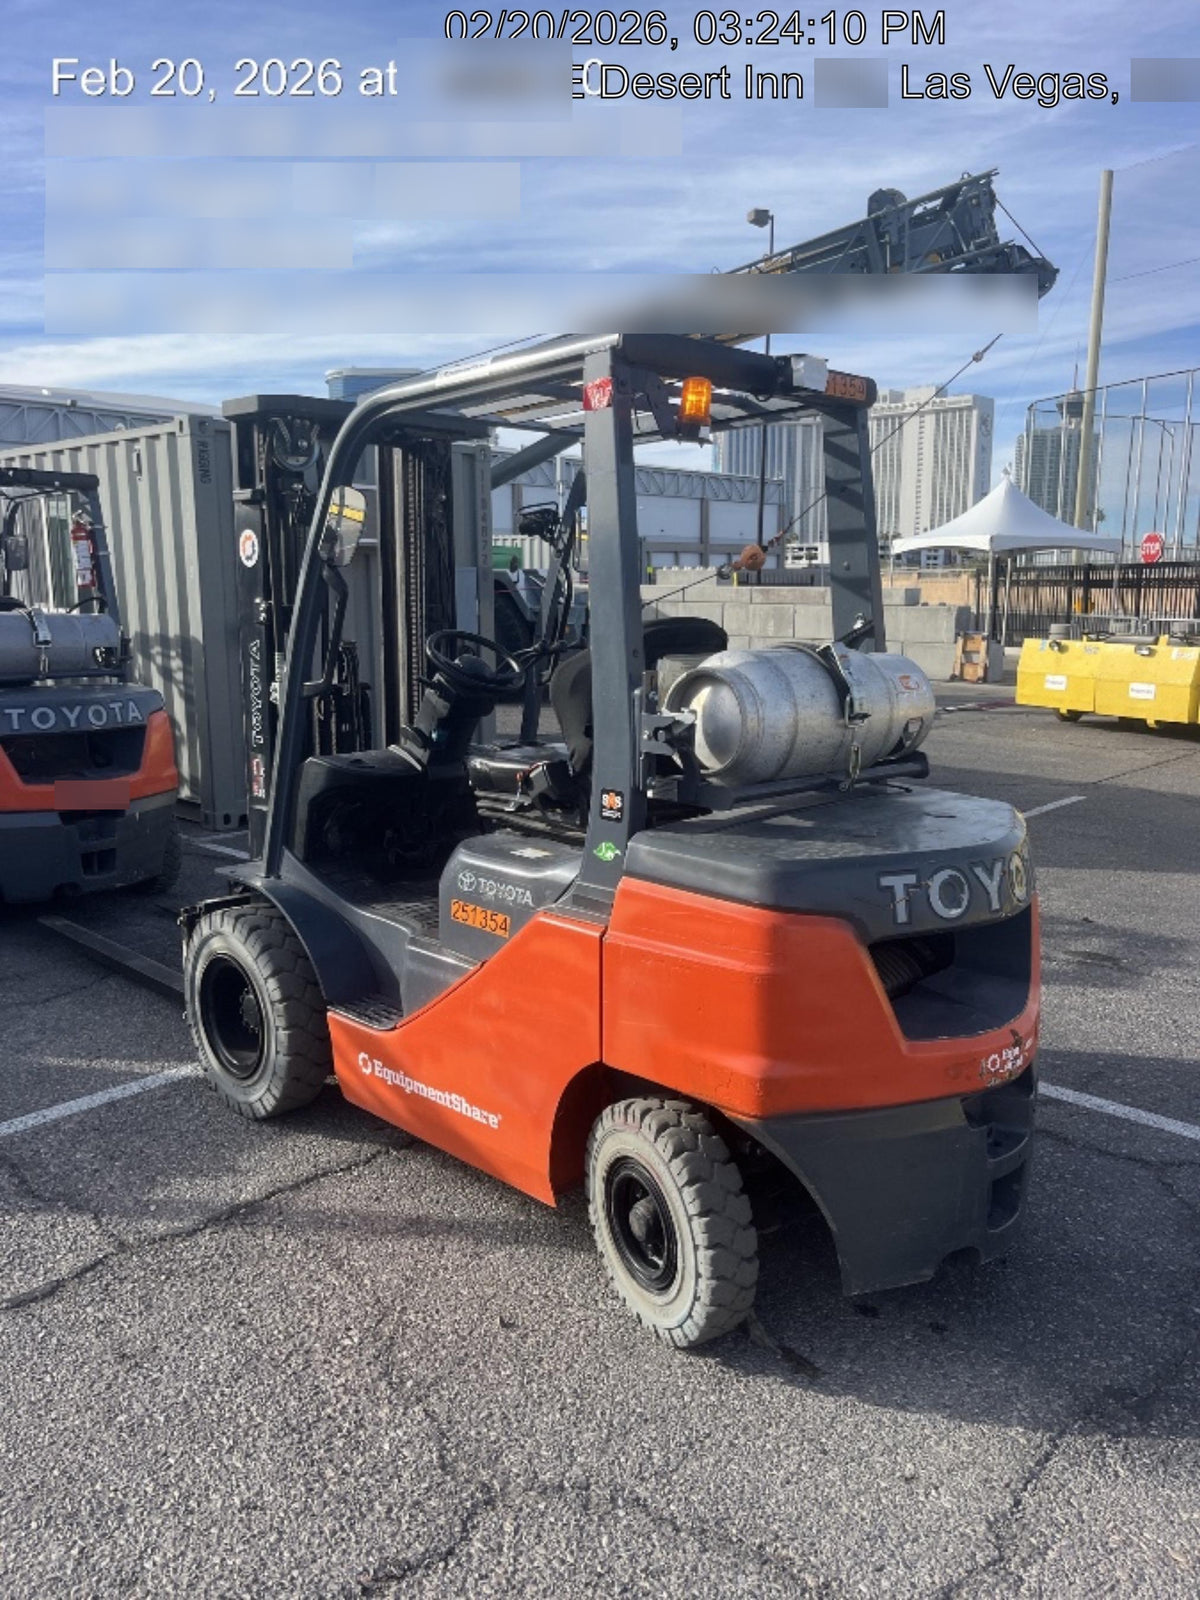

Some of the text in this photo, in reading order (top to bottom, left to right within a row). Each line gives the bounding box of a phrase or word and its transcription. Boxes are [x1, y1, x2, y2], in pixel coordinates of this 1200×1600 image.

[1142, 542, 1160, 556] STOP
[249, 639, 264, 747] TOYOTA
[3, 701, 143, 730] TOYOTA
[478, 877, 534, 907] TOYOTA
[452, 900, 508, 932] 251354
[373, 1058, 499, 1129] EquipmentShare
